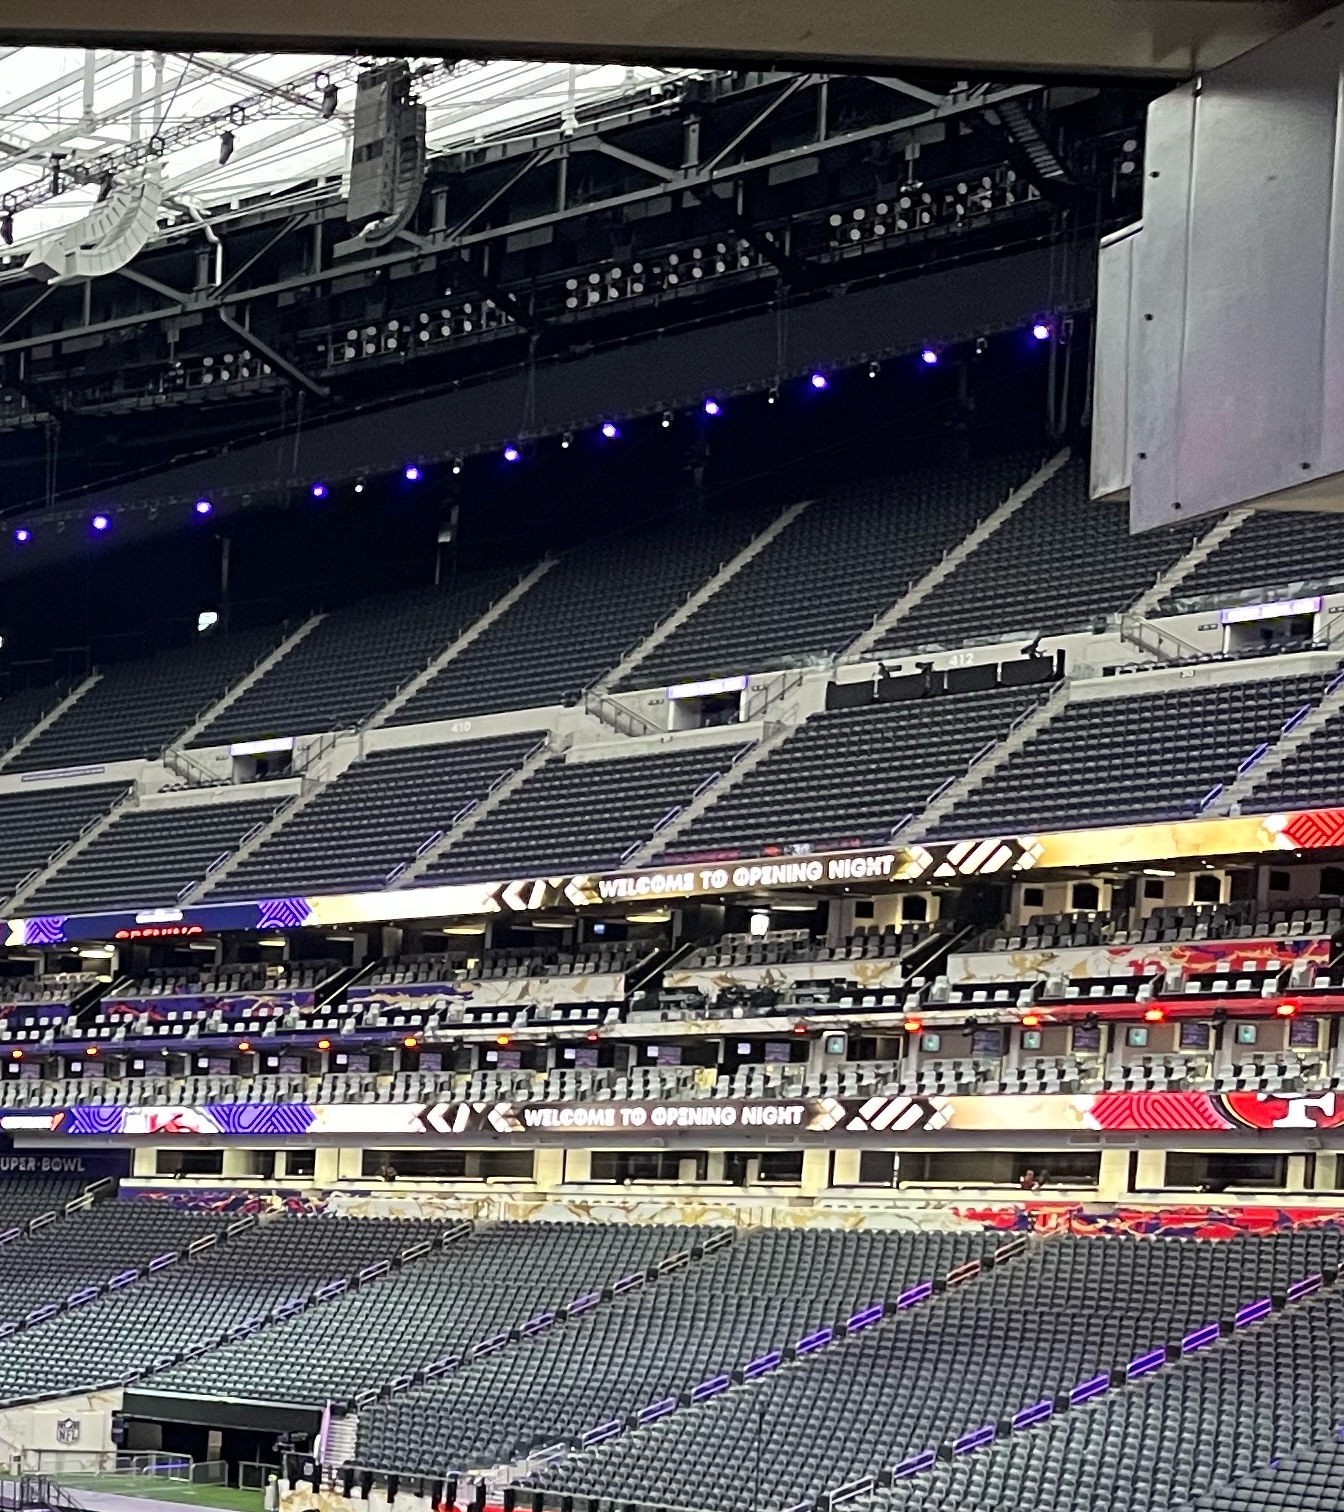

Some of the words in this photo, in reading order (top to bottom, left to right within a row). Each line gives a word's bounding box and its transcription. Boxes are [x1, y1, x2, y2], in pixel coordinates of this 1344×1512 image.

[949, 652, 974, 666] 412
[599, 873, 694, 899] WELCOME
[700, 869, 728, 890] TO
[732, 860, 824, 887] OPENING
[828, 855, 895, 880] NIGHT
[524, 1108, 615, 1127] WELCOME
[621, 1107, 646, 1126] TO
[651, 1106, 735, 1127] OPENING
[740, 1105, 805, 1127] NIGHT
[41, 1157, 85, 1172] BOWL
